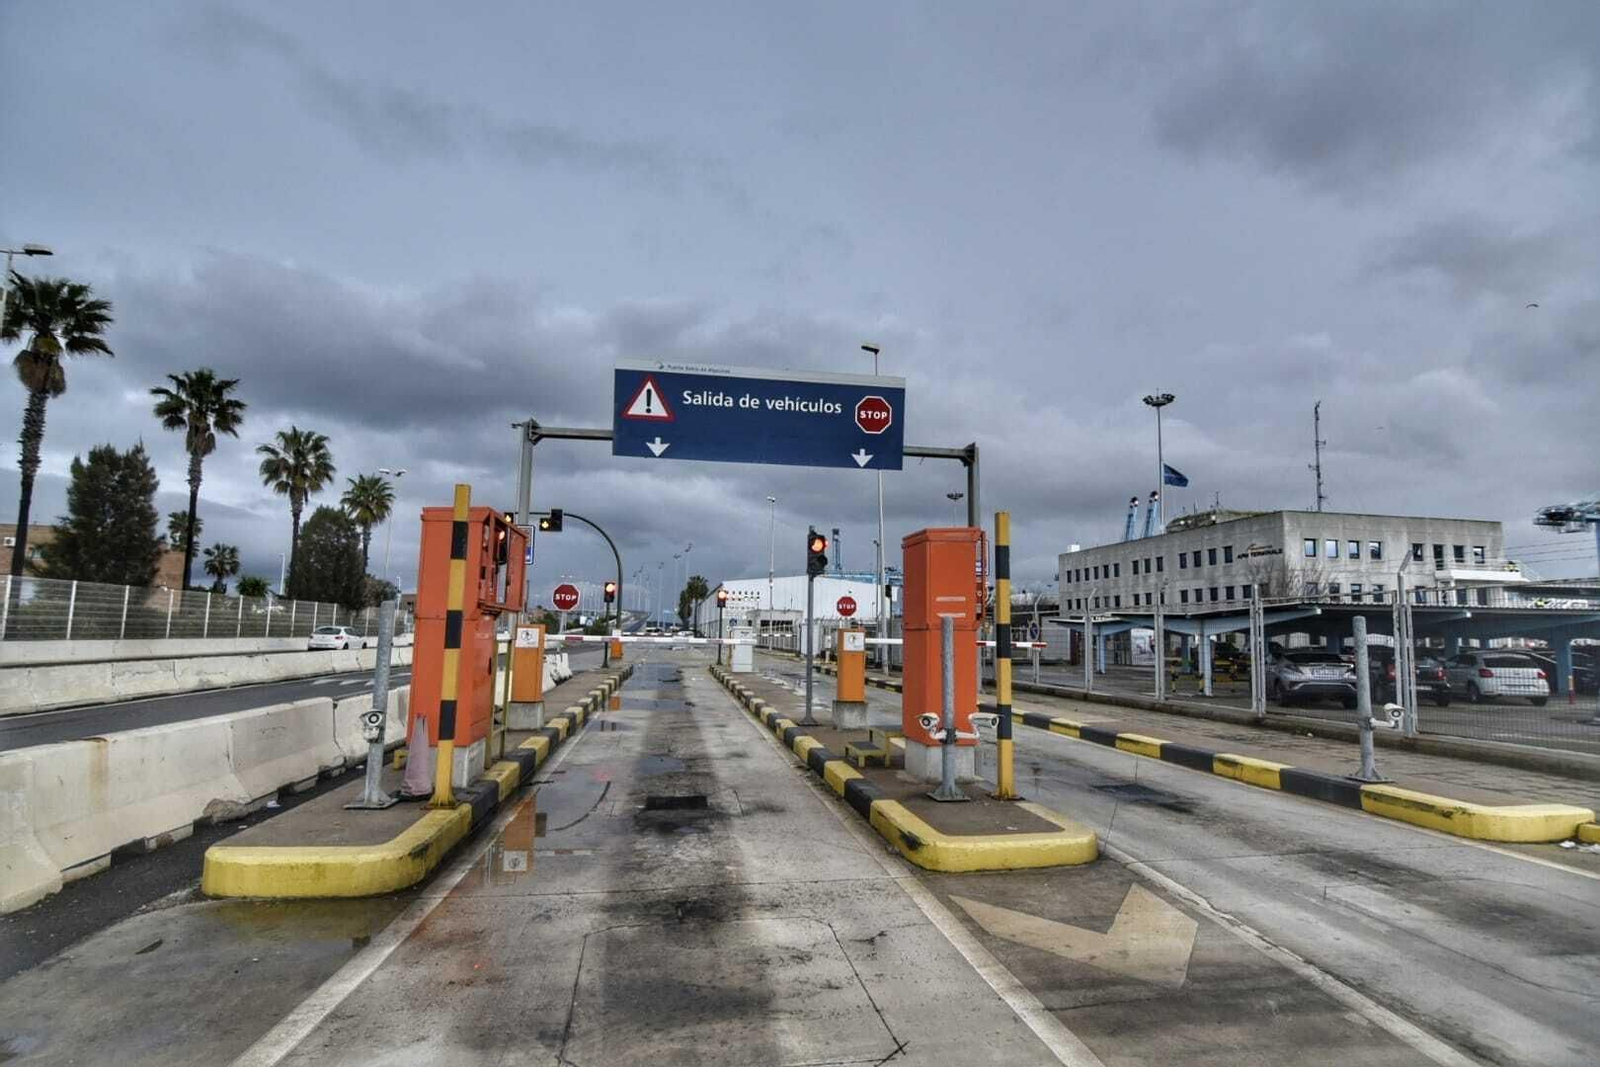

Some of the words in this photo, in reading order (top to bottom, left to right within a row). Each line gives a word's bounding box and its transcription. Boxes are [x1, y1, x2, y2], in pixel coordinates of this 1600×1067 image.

[682, 390, 733, 408] Salida
[739, 393, 760, 409] de
[766, 396, 842, 414] vehículos
[860, 410, 888, 420] STOP
[555, 593, 577, 601] STOP
